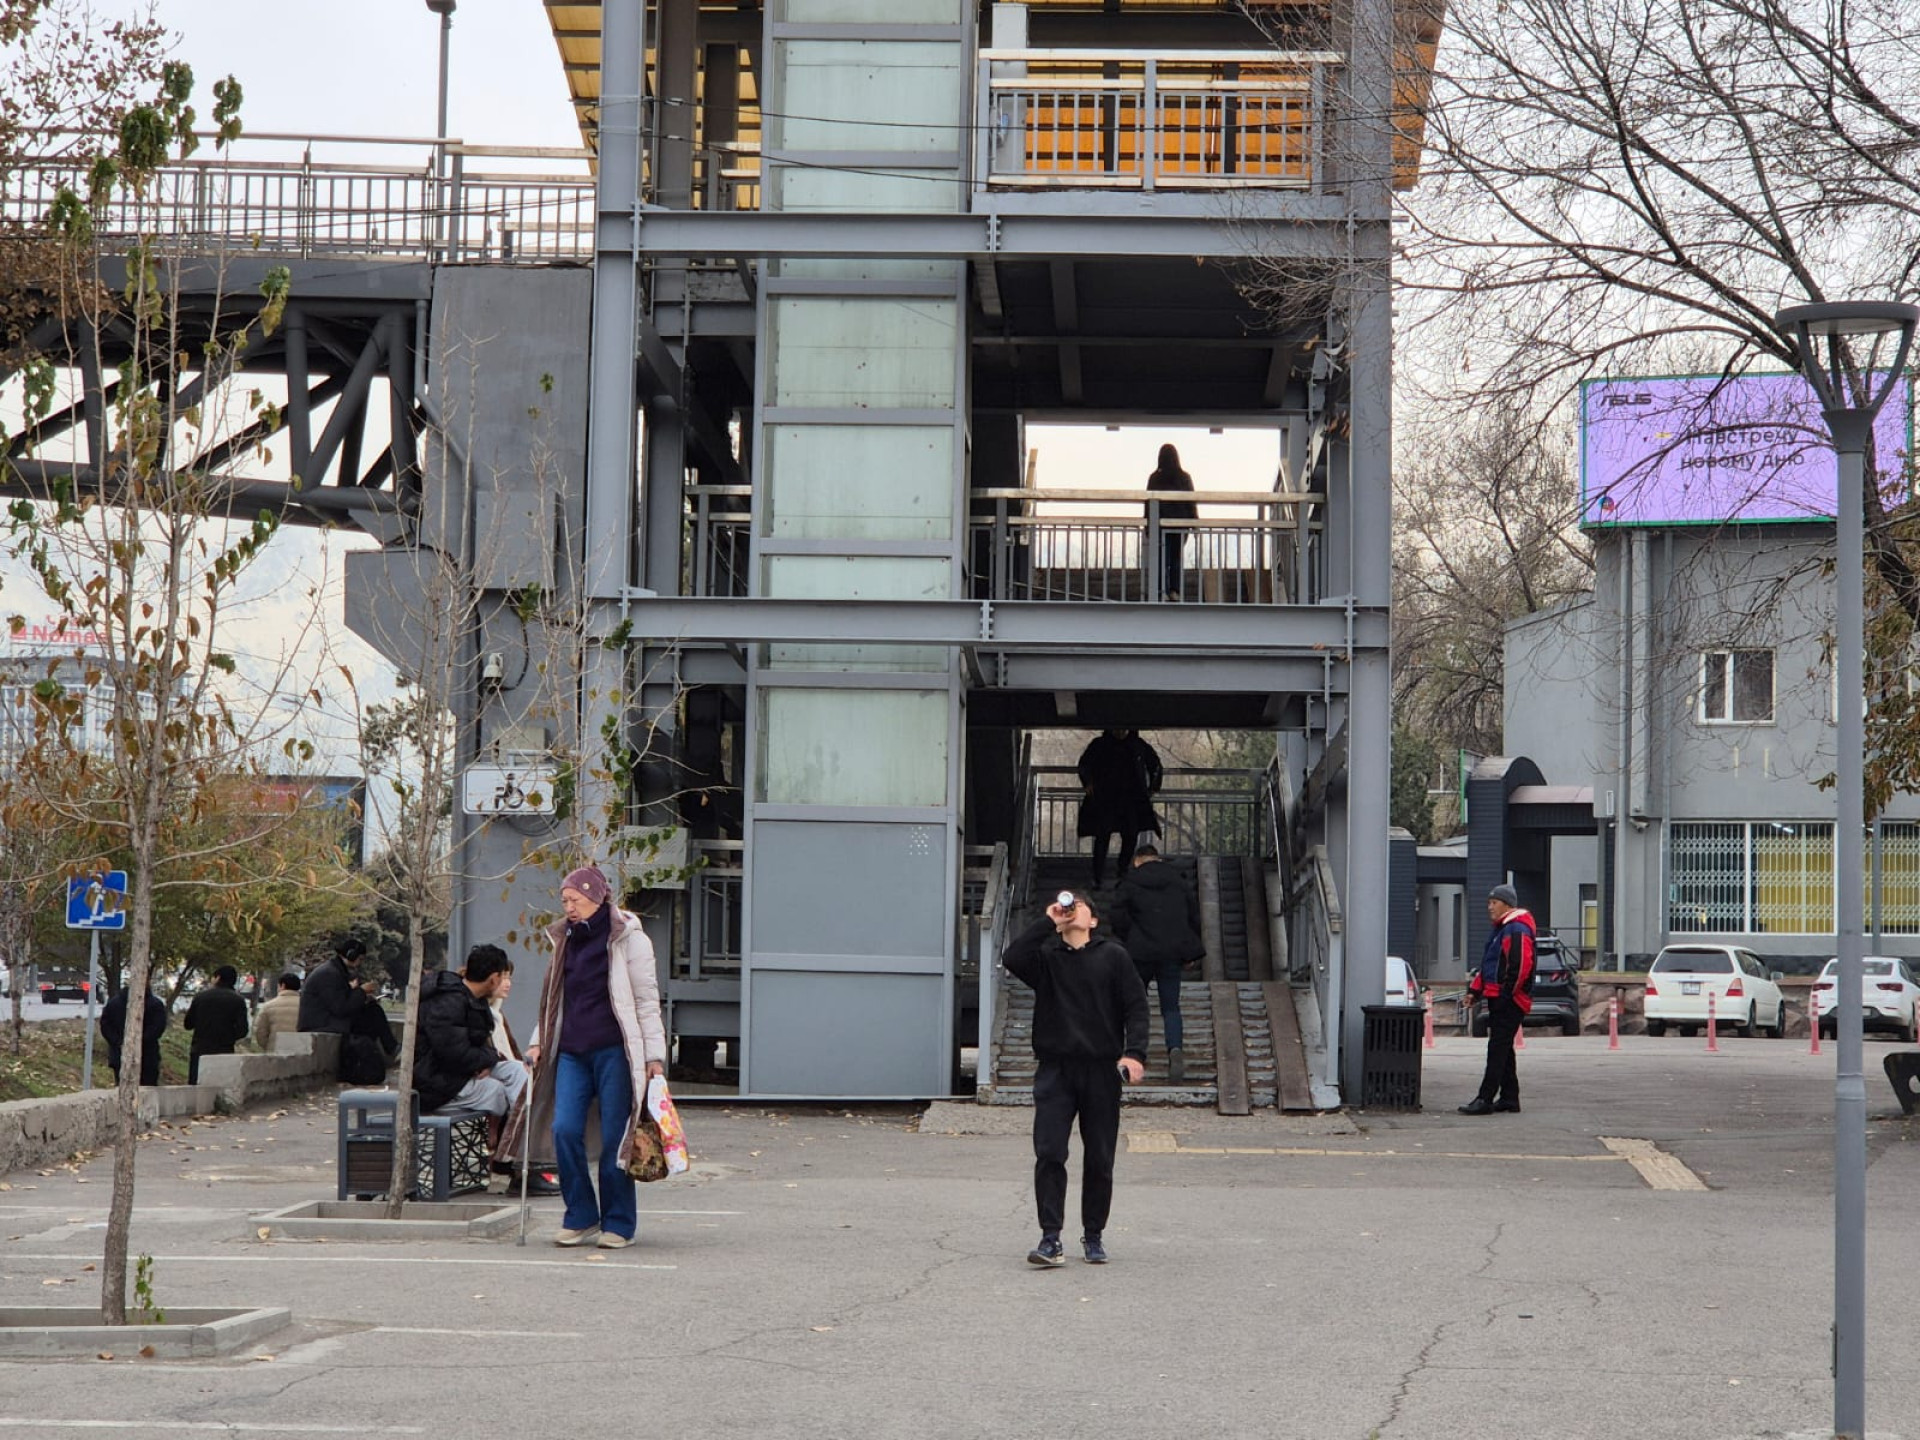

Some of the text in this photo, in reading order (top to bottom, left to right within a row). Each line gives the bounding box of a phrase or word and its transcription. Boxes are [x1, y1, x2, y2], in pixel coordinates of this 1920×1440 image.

[1600, 393, 1652, 406] ASUS
[1681, 453, 1805, 472] новому дню
